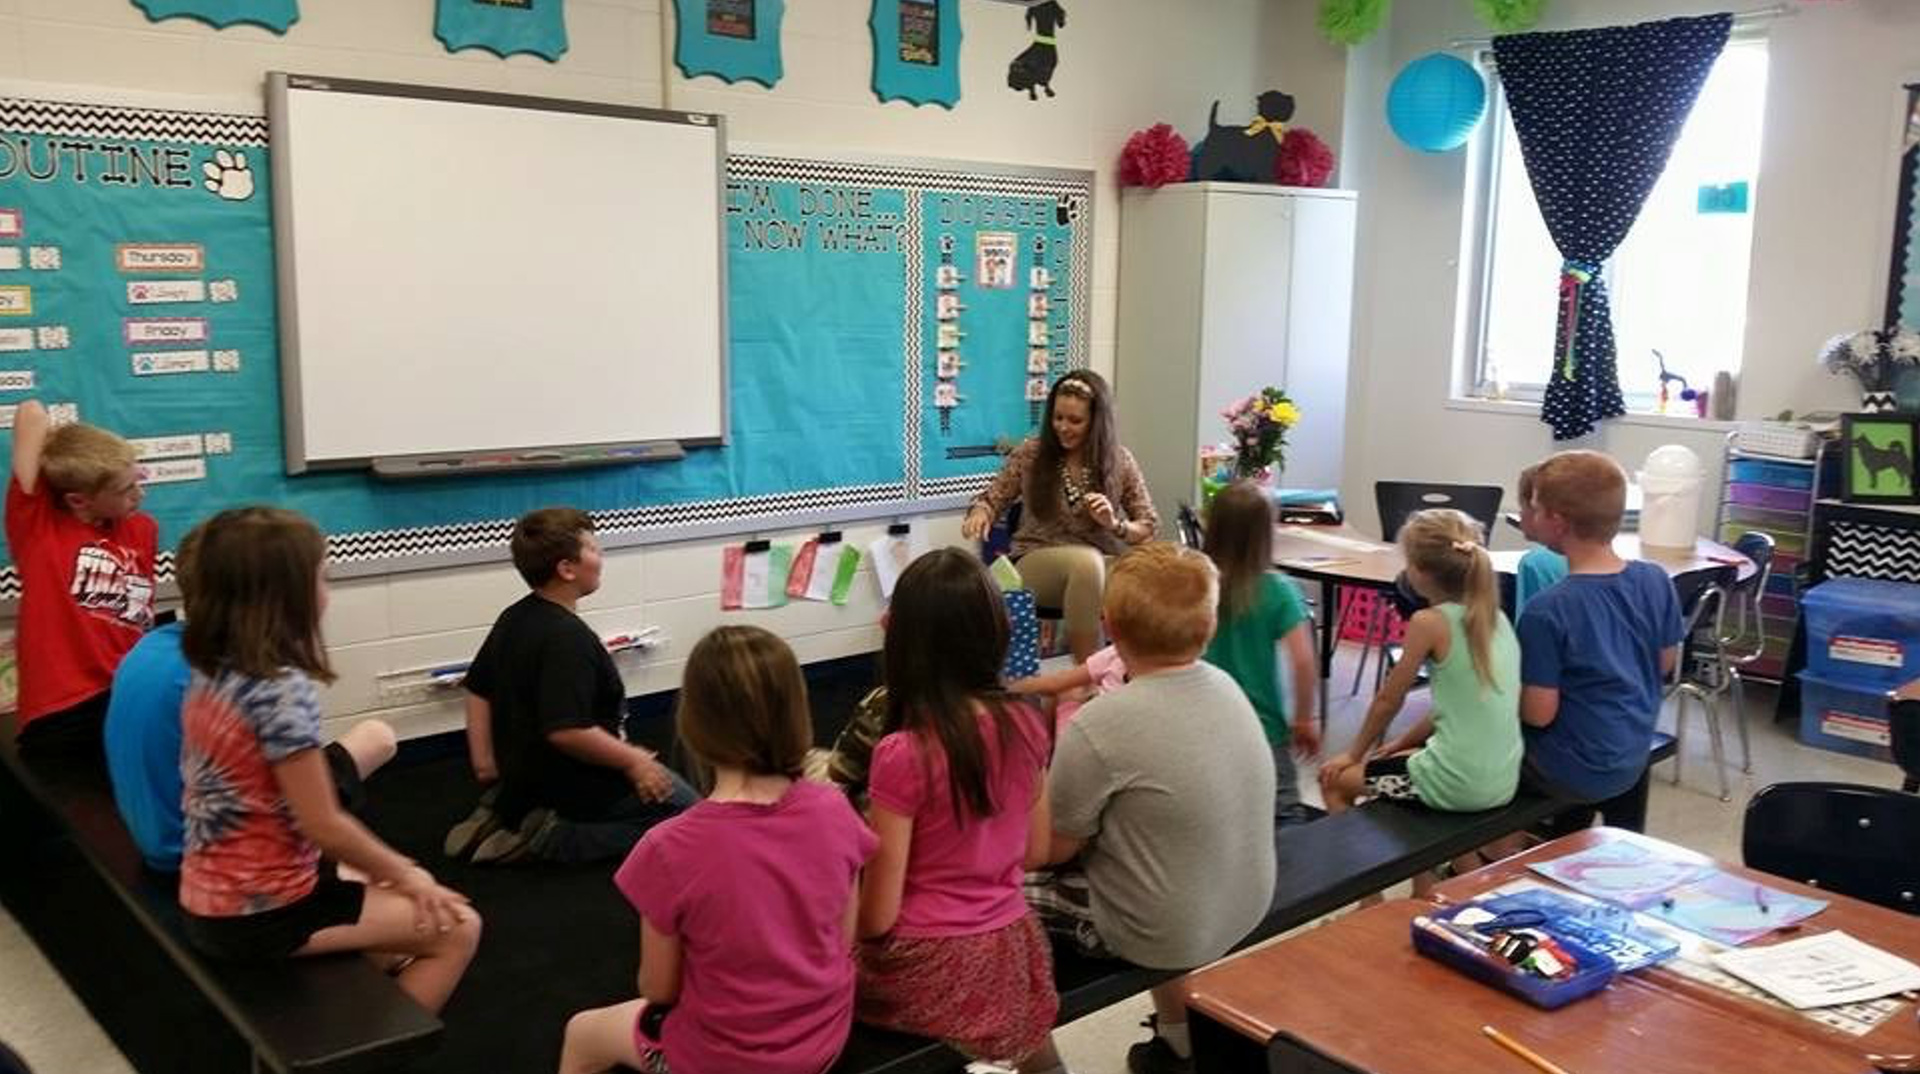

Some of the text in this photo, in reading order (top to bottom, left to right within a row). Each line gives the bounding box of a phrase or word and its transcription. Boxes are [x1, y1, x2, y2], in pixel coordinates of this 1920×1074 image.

[725, 183, 777, 215] I'M
[743, 218, 908, 253] NOW WHAT?
[128, 250, 193, 264] Thursday
[144, 324, 189, 337] Friday
